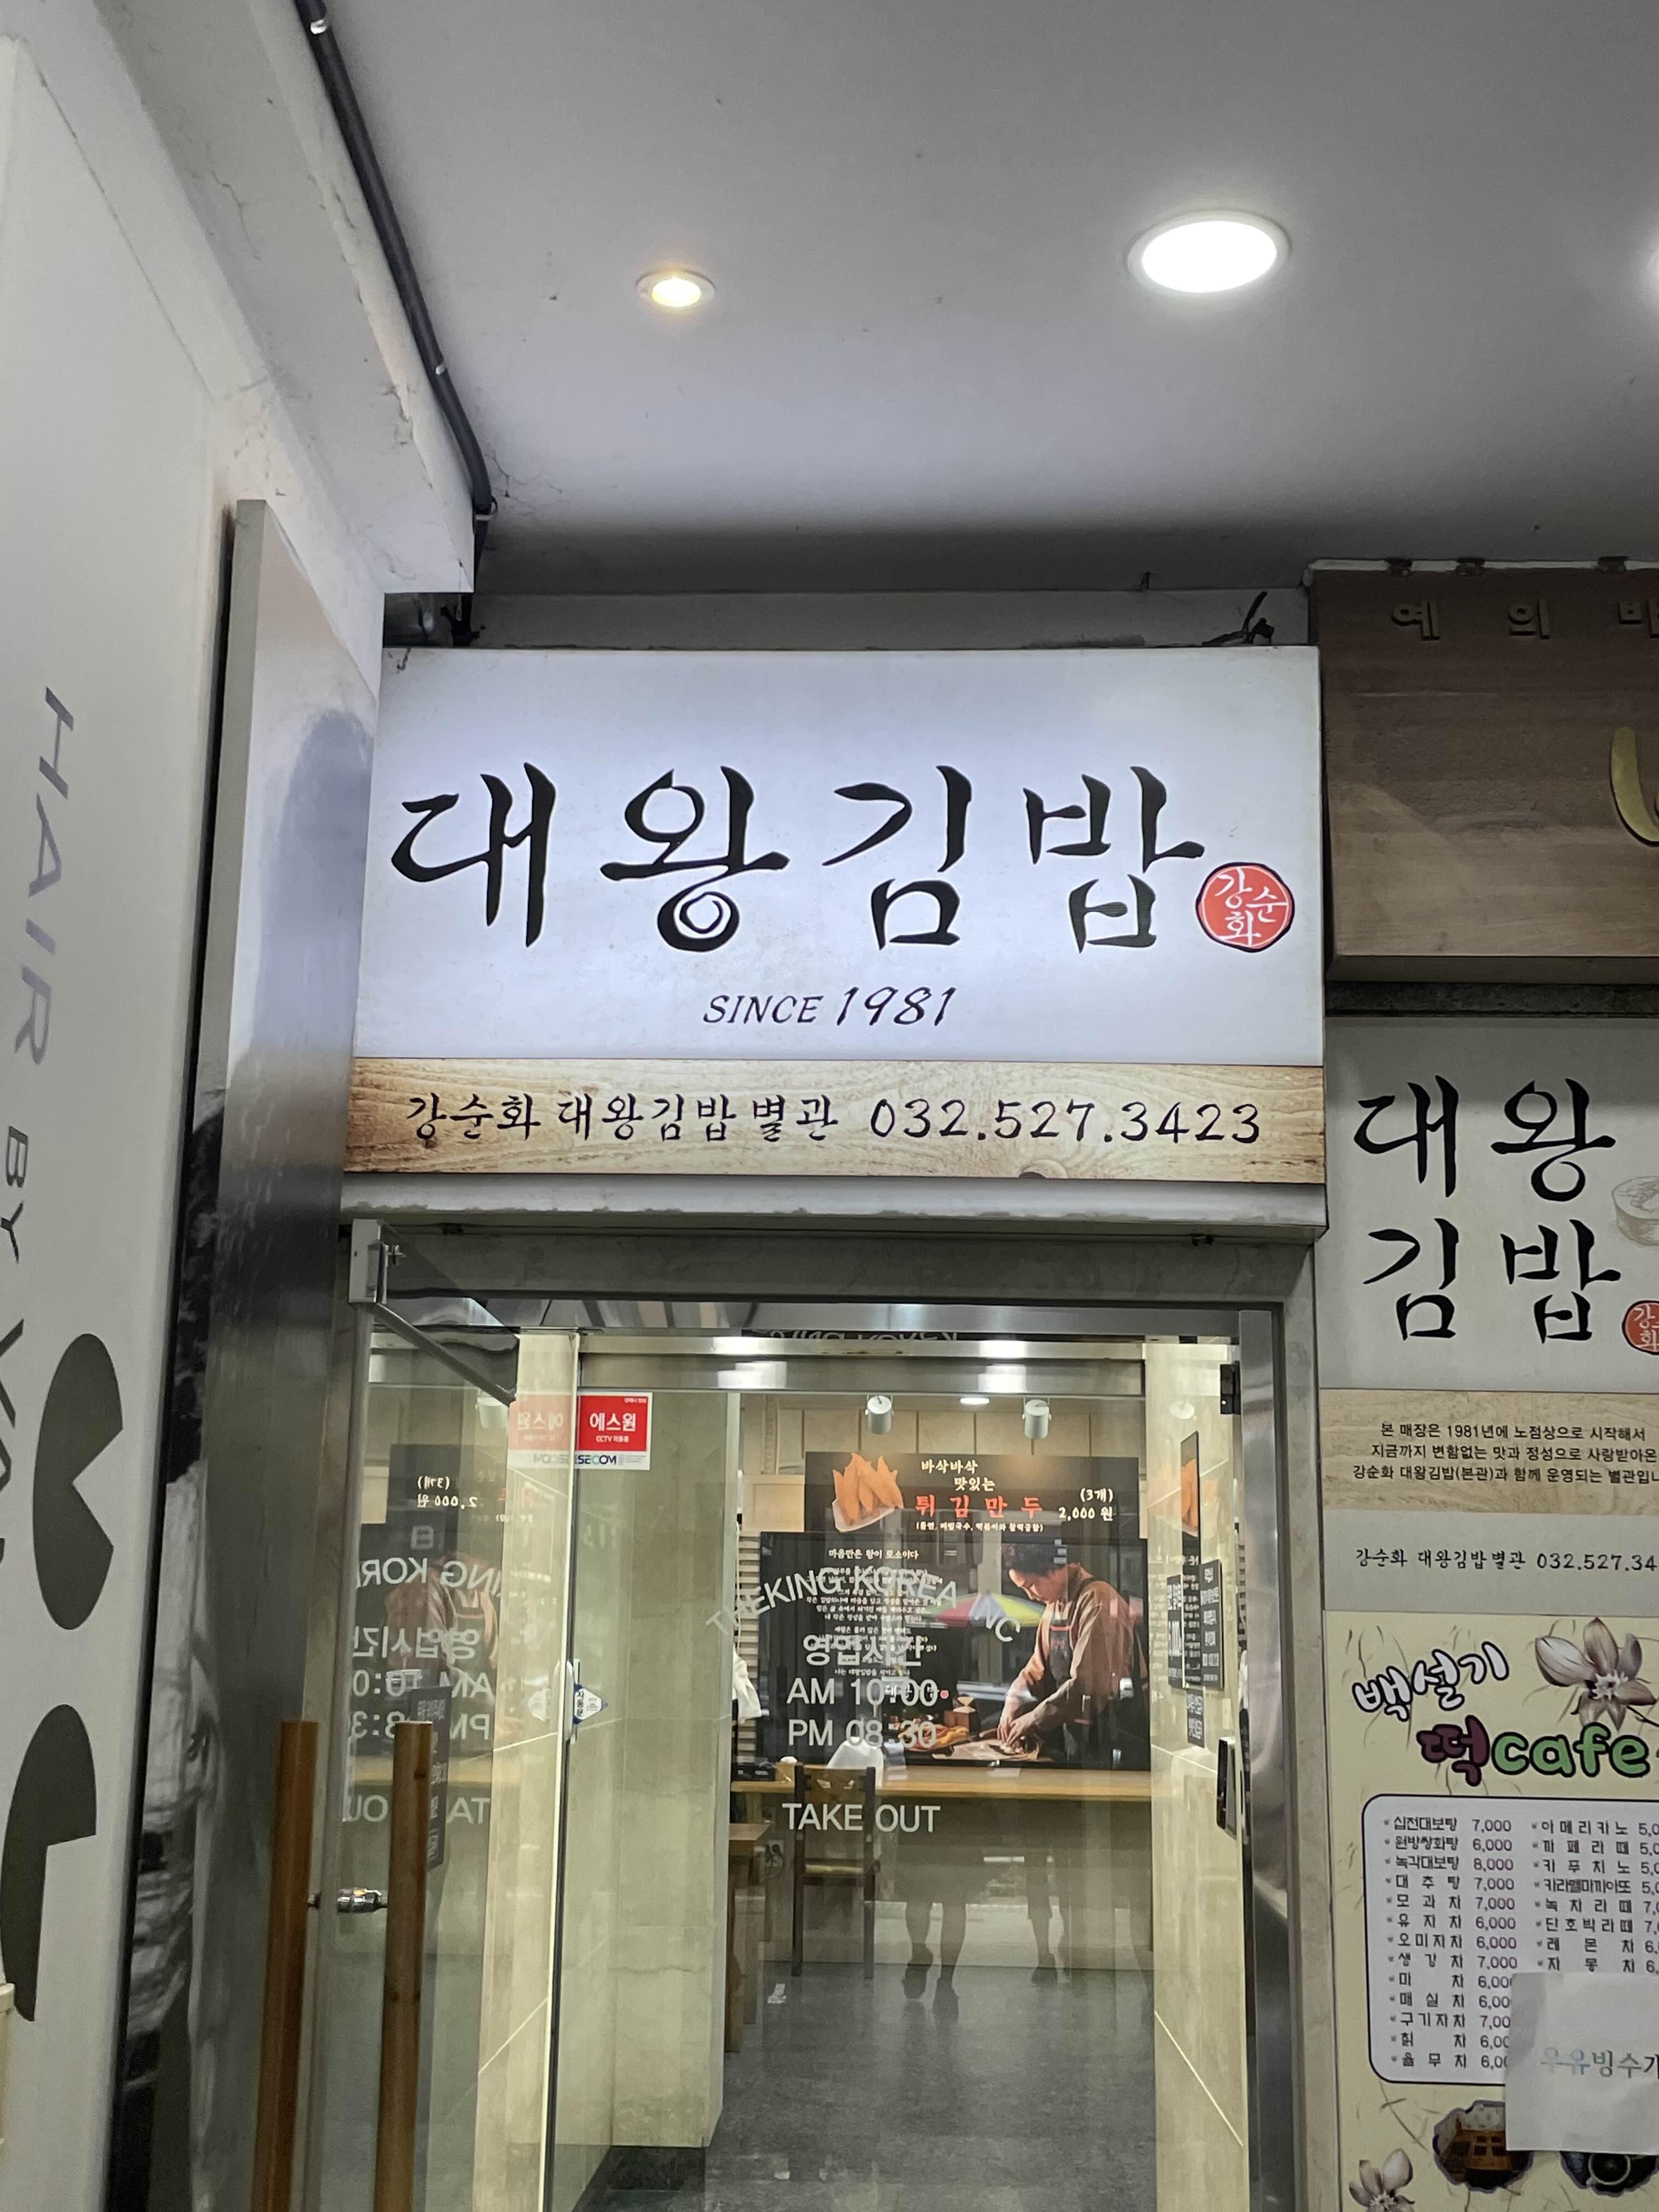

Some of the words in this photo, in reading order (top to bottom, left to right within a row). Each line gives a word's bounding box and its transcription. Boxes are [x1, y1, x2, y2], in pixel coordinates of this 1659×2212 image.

[390, 763, 1205, 953] 대왕김밥
[15, 687, 74, 1065] HAIR
[702, 994, 823, 1026] SINCE
[835, 986, 958, 1028] 1981
[408, 1093, 541, 1149] 강순화
[557, 1092, 740, 1145] 대왕김밥
[752, 1094, 838, 1144] 별관
[870, 1097, 1260, 1146] 032.527.3423
[1353, 1074, 1617, 1203] 대왕
[1363, 1217, 1622, 1344] 김밥
[590, 1413, 637, 1432] 에스원
[1381, 1423, 1395, 1437] 본
[1400, 1424, 1441, 1438] 매장은
[1447, 1424, 1508, 1439] 1981년에
[1514, 1425, 1585, 1440] 노점상으로
[1590, 1426, 1646, 1442] 시작해서
[578, 1454, 617, 1465] SECOM
[1372, 1444, 1426, 1459] 지금까지
[1432, 1444, 1488, 1460] 변함없는
[1492, 1446, 1521, 1460] 맛과
[1526, 1447, 1583, 1462] 정성으로
[1588, 1447, 1658, 1463] 사랑받아온
[921, 1459, 979, 1475] 바삭바삭
[1353, 1464, 1395, 1480] 강순화
[1400, 1465, 1508, 1481] 대왕김밥(본관)과
[1514, 1467, 1541, 1482] 함께
[1547, 1468, 1603, 1483] 운영되는
[953, 1476, 996, 1492] 맛있는
[1079, 1487, 1114, 1503] (3개)
[915, 1494, 1043, 1520] 튀김만두
[1058, 1506, 1096, 1522] 2,000
[1099, 1506, 1115, 1522] 원
[828, 1549, 862, 1560] 마음만은
[1356, 1548, 1408, 1568] 강순화
[1418, 1549, 1487, 1570] 대왕김밥
[1491, 1550, 1527, 1570] 별관
[1536, 1552, 1657, 1572] 032.527.34
[853, 1565, 957, 1610] KOREA
[968, 1592, 1021, 1643] INC
[1352, 1641, 1510, 1722] 백설기
[787, 1677, 835, 1705] AM
[850, 1678, 939, 1707] 10:00
[788, 1719, 833, 1747] PM
[845, 1719, 937, 1749] 08:30
[782, 1803, 863, 1831] TAKE
[875, 1804, 941, 1833] OUT
[1394, 1816, 1458, 1832] 십전대보탕
[1471, 1818, 1512, 1833] 7,000
[1542, 1819, 1629, 1835] 아메리카노
[1472, 1838, 1513, 1853] 6,000
[1396, 1855, 1459, 1871] 녹각대보탕
[1473, 1858, 1514, 1872] 8,000
[1543, 1858, 1630, 1874] 카푸치노
[1396, 1874, 1460, 1890] 대추탕
[1474, 1877, 1515, 1892] 7,000
[1396, 1894, 1461, 1910] 모과차
[1475, 1897, 1515, 1911] 7,000
[1397, 1913, 1462, 1929] 유자차
[1475, 1916, 1516, 1931] 6,000
[1545, 1917, 1633, 1933] 단호박라떼
[1397, 1933, 1463, 1949] 오미자차
[1476, 1936, 1517, 1951] 6,000
[1398, 1953, 1463, 1969] 생강차
[1477, 1955, 1518, 1970] 7,000
[1478, 1975, 1513, 1990] 6,00
[1400, 1991, 1465, 2008] 매실차
[1400, 2012, 1465, 2028] 구기자차
